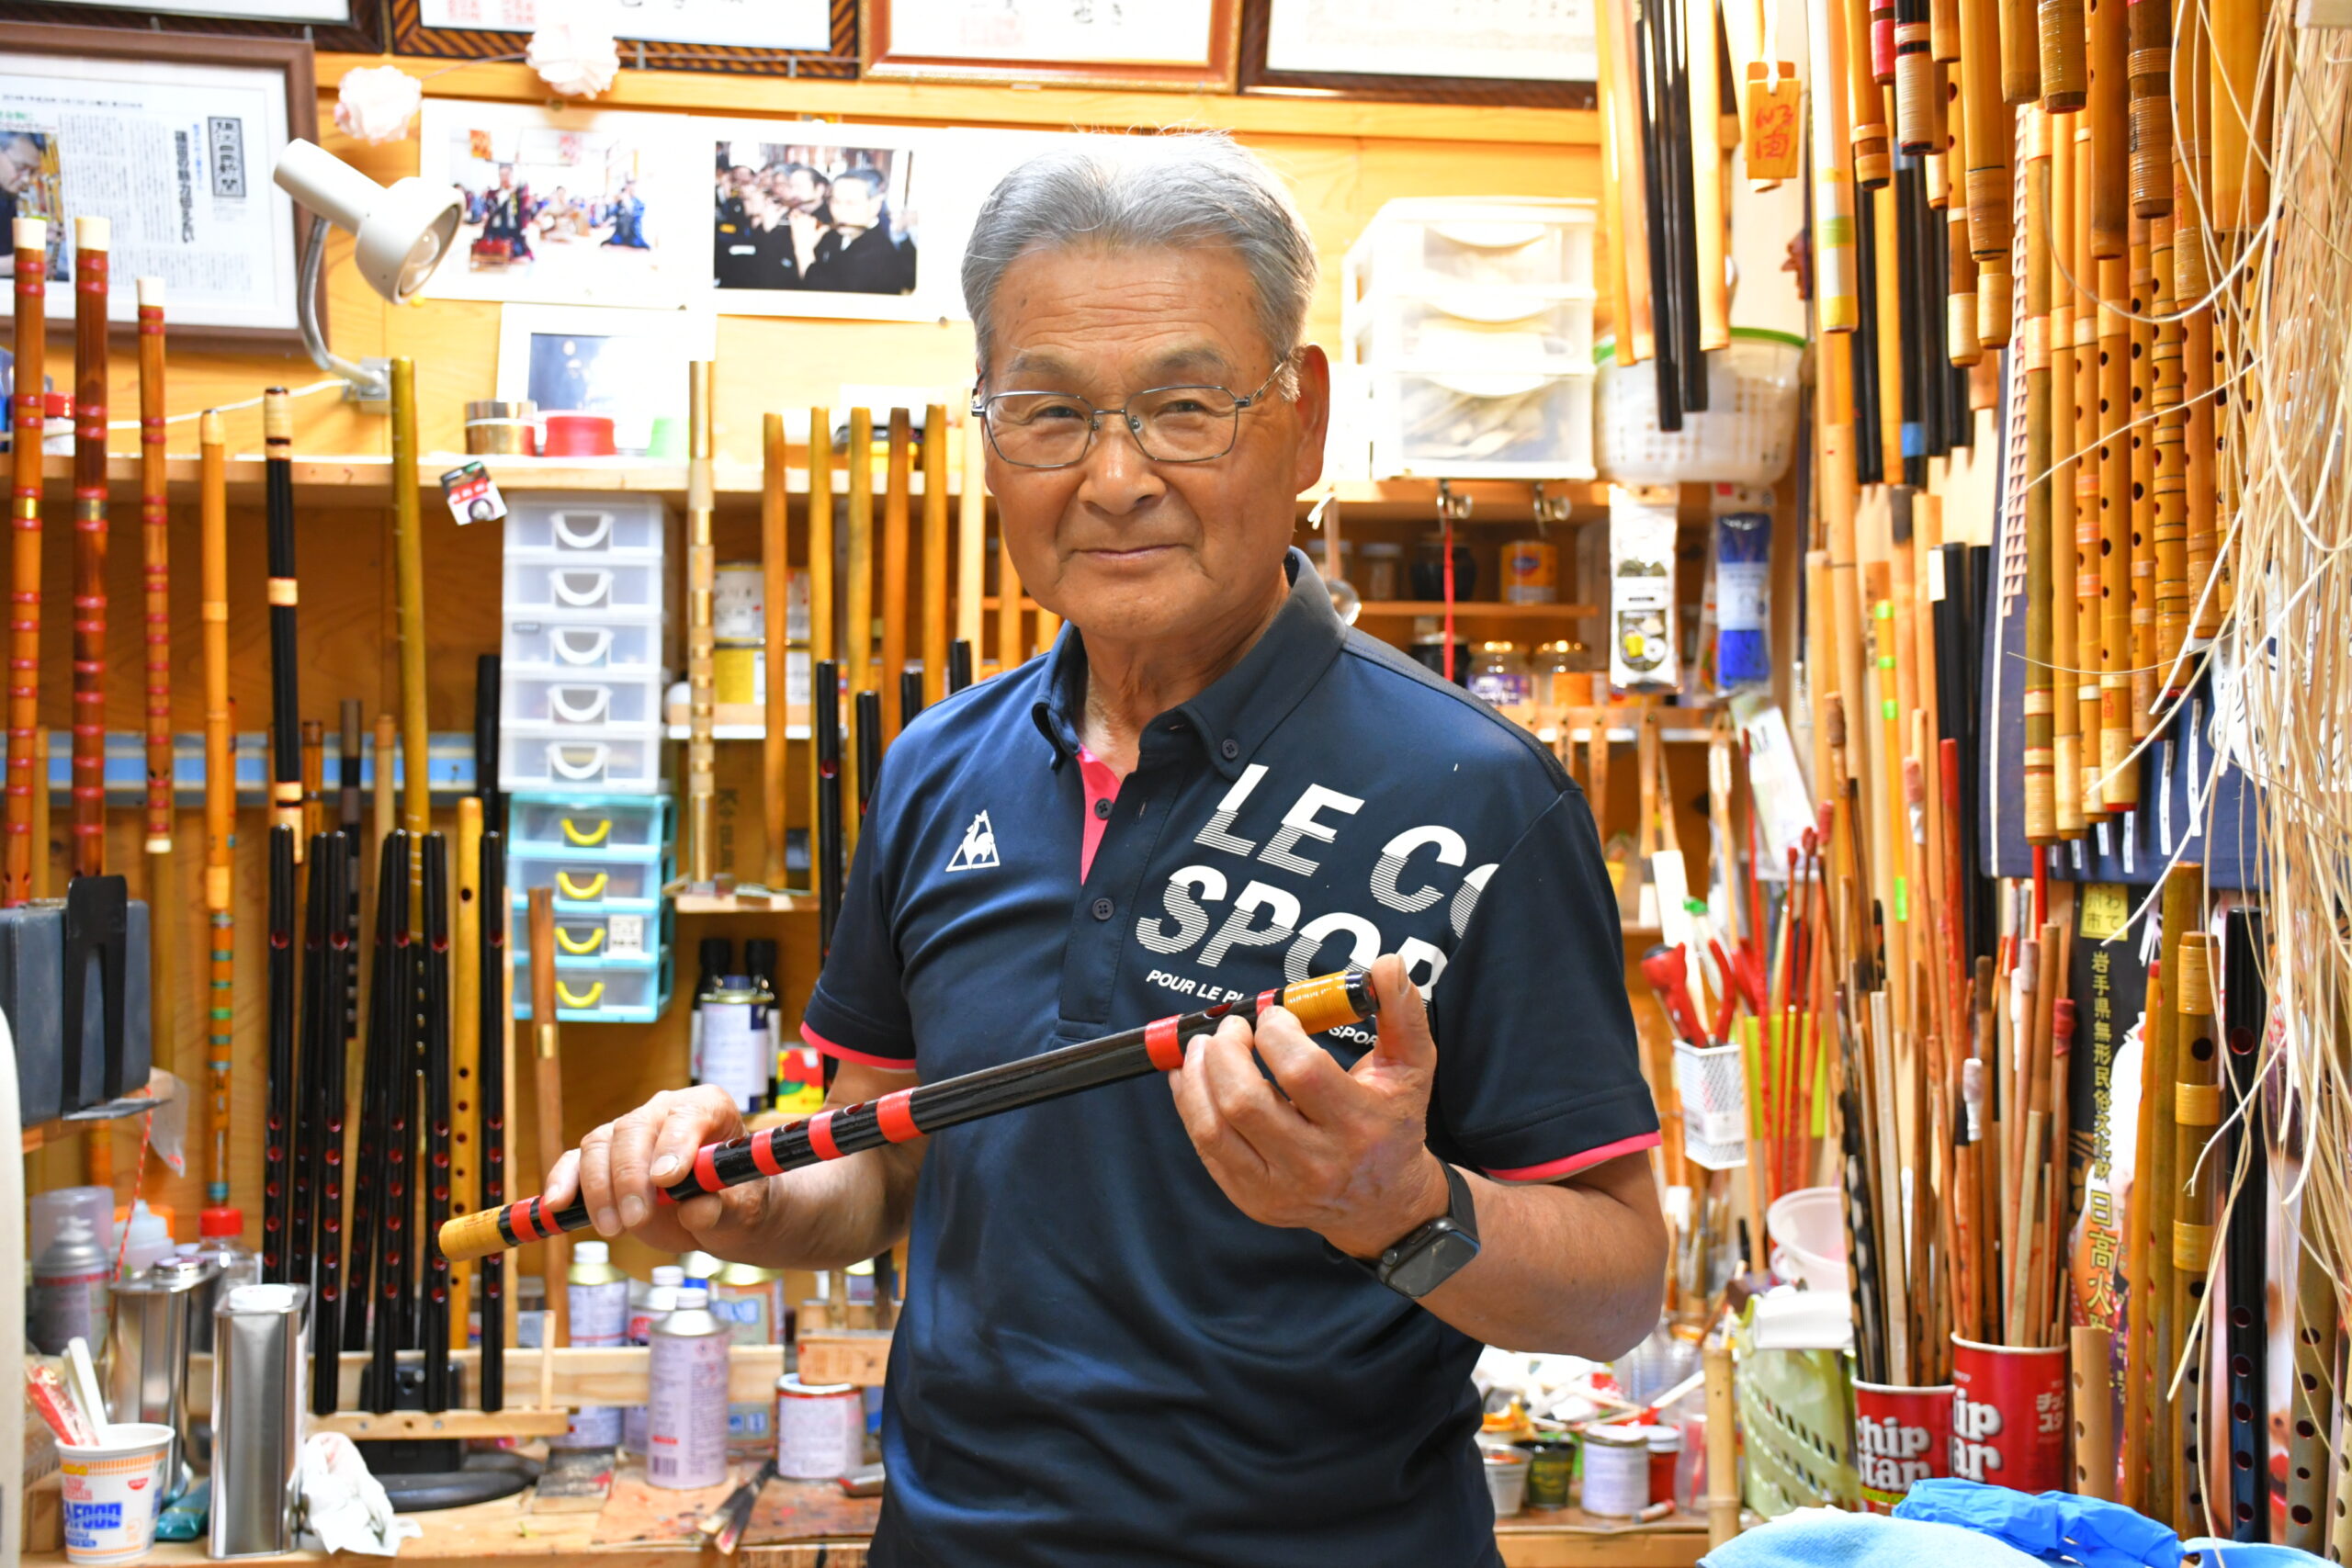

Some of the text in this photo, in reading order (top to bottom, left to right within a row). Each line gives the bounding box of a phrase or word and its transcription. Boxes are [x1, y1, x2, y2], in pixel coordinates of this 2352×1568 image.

[1193, 763, 1365, 876] LE
[1146, 969, 1196, 994] POUR
[1196, 983, 1223, 1000] LE
